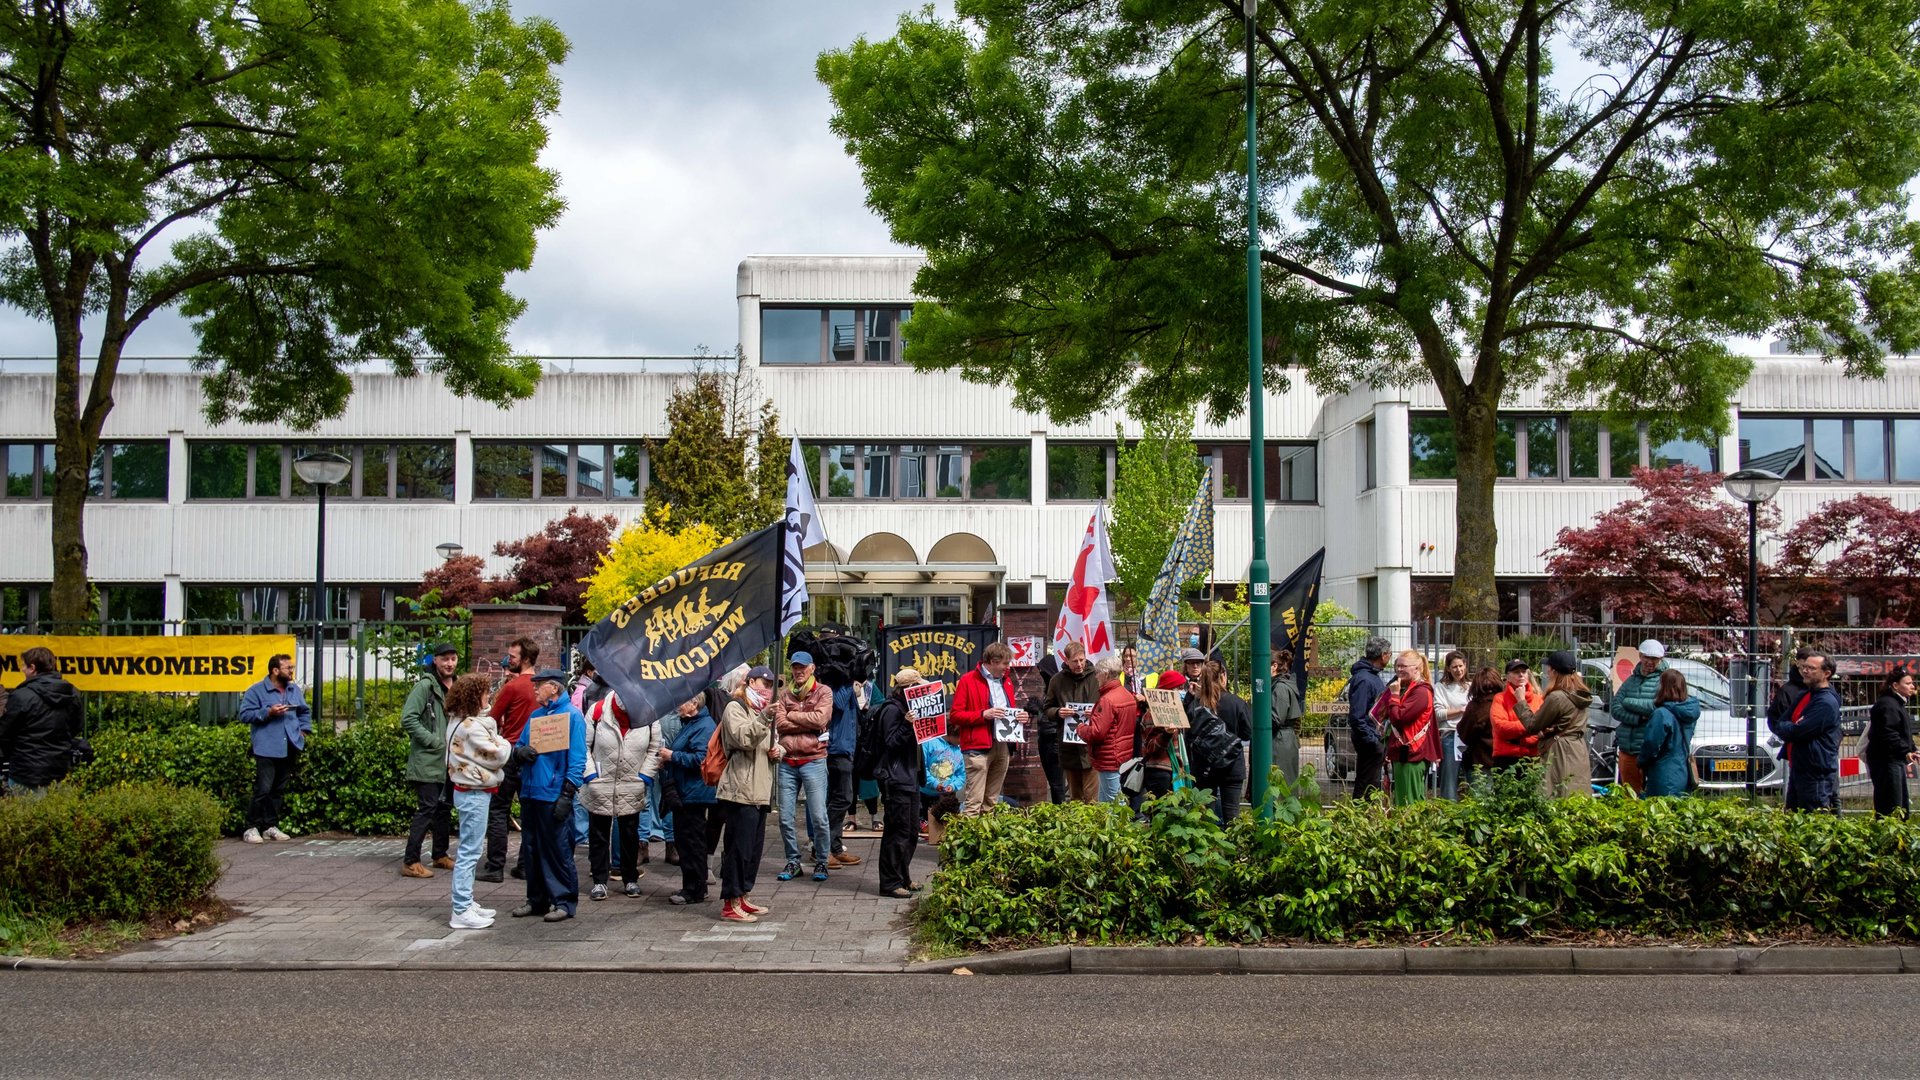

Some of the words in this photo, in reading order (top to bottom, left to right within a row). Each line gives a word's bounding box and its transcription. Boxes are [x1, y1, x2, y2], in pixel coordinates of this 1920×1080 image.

[889, 632, 976, 655] REFUGEES
[54, 655, 255, 675] EUWKOMERS!
[908, 685, 932, 699] GEEF
[911, 693, 942, 710] ANGST
[920, 703, 944, 718] HAAT
[914, 717, 937, 730] GEEN
[917, 725, 939, 740] STEM
